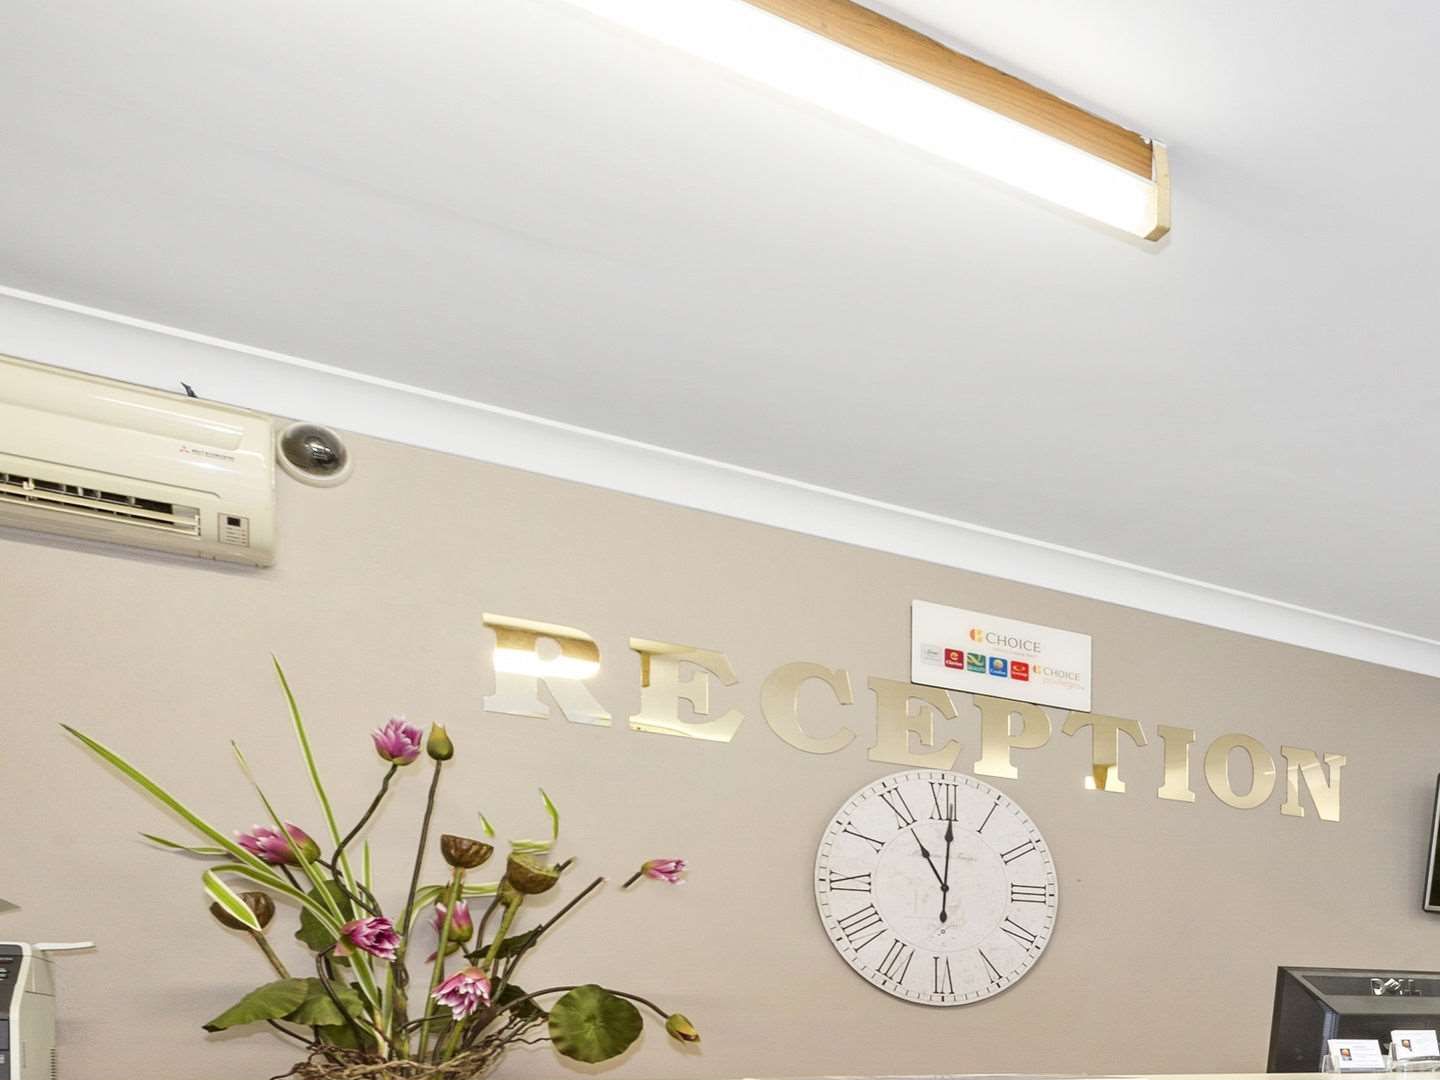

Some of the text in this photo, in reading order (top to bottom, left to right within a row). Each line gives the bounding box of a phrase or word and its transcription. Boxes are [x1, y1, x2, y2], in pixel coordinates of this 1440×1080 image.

[985, 632, 1041, 653] CHOICE
[1043, 667, 1081, 681] CHOICE
[481, 613, 1348, 822] RECEPTION
[879, 787, 918, 830] XI
[976, 802, 999, 834] I
[842, 821, 886, 853] X
[1000, 840, 1037, 865] II
[829, 870, 872, 893] IX
[1010, 882, 1047, 904] III
[837, 903, 888, 953] VIII
[1000, 916, 1038, 952] IV
[875, 938, 915, 985] VII
[933, 955, 955, 994] VI
[978, 948, 1003, 985] V
